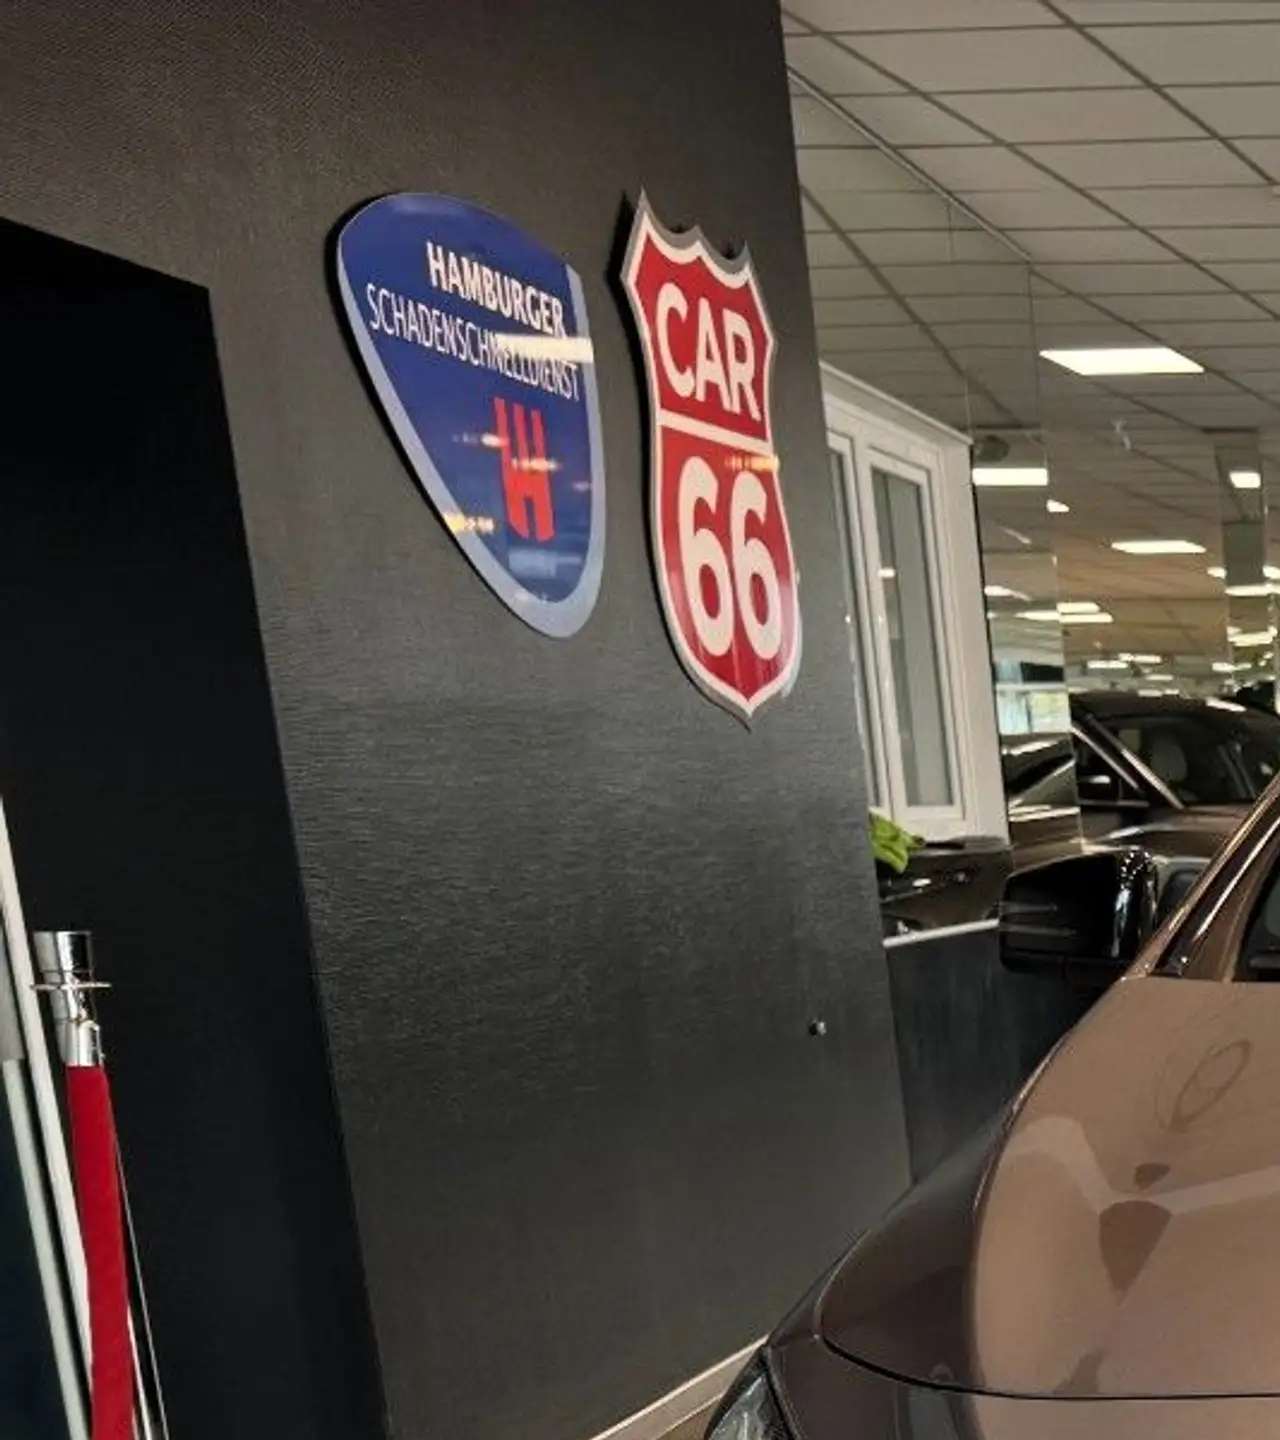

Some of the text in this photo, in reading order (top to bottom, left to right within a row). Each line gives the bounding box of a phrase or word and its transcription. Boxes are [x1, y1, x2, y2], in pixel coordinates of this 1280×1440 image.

[426, 241, 568, 340] HAMBURGER
[656, 281, 761, 421] CAR
[677, 455, 783, 660] 66
